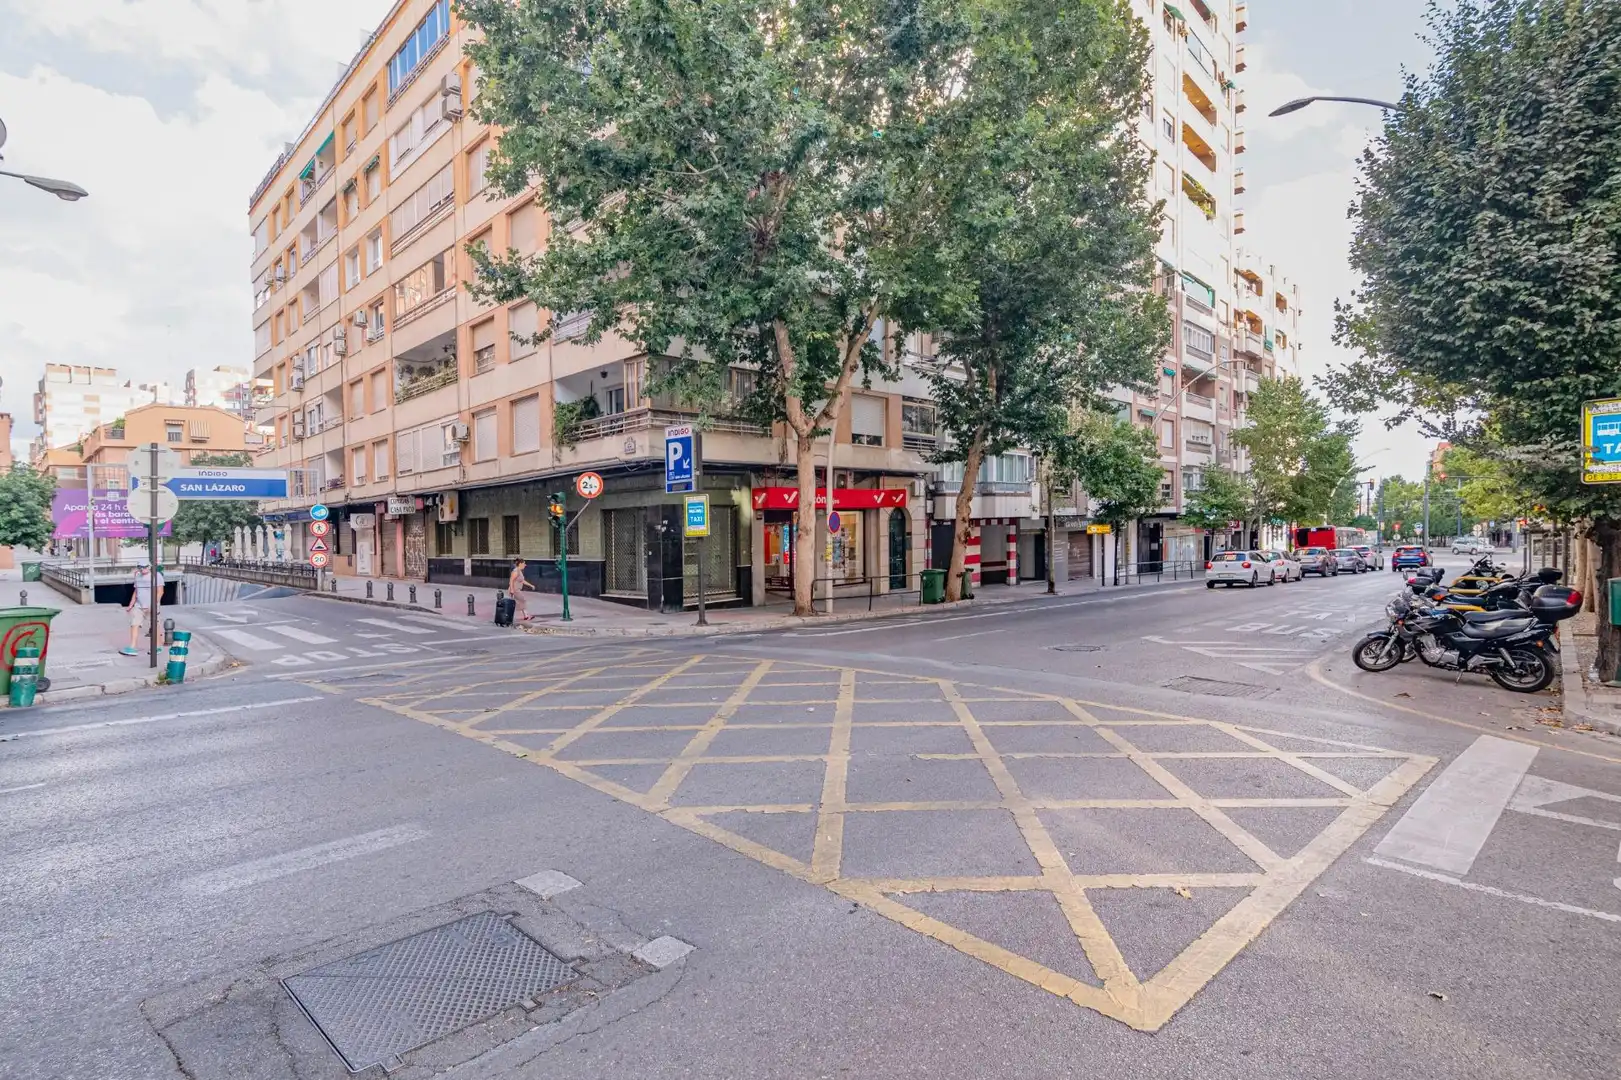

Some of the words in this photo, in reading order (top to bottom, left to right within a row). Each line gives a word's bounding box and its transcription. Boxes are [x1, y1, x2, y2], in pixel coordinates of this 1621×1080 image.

[667, 427, 690, 437] INDIGO
[668, 441, 683, 470] P
[180, 484, 203, 492] SAN
[205, 481, 246, 492] LÁZARO
[63, 503, 98, 512] Apara
[101, 503, 112, 511] 24
[114, 503, 121, 511] h
[1225, 622, 1344, 638] BUS
